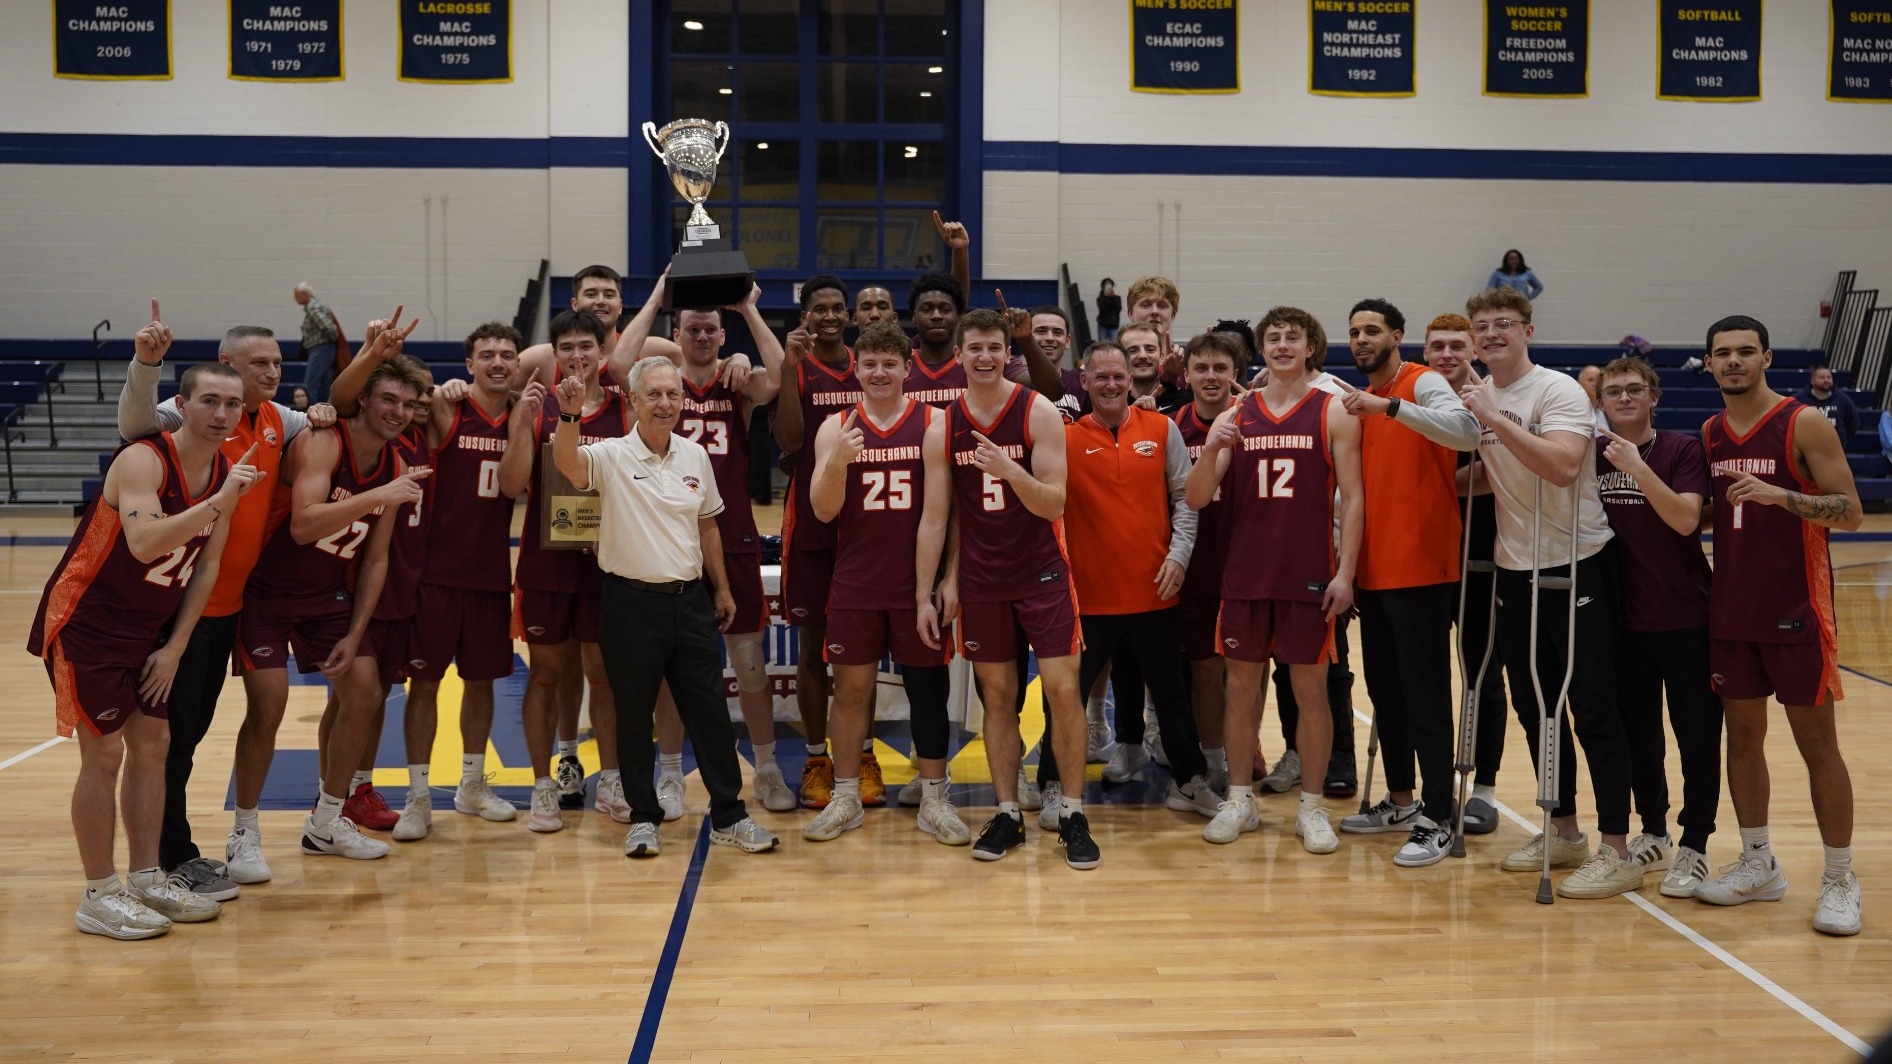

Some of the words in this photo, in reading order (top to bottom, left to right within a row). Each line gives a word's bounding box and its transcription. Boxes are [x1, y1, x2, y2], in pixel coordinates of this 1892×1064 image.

[95, 6, 129, 18] MAC
[269, 6, 302, 18] MAC
[418, 2, 492, 15] LACROSSE
[1314, 1, 1355, 13] MEN'S
[1357, 2, 1410, 14] SOCCER
[1505, 6, 1569, 18] WOMEN'S
[1677, 9, 1742, 22] SOFTBALL
[1849, 11, 1892, 24] SOFTB
[68, 19, 155, 32] CHAMPIONS
[242, 18, 329, 31] CHAMPIONS
[439, 21, 471, 33] MAC
[1165, 22, 1203, 34] ECAC
[1347, 20, 1378, 31] MAC
[1510, 20, 1563, 32] SOCCER
[412, 34, 497, 47] CHAMPIONS
[1144, 34, 1225, 48] CHAMPIONS
[1322, 31, 1402, 45] NORTHEAST
[1505, 37, 1567, 50] FREEDOM
[1694, 36, 1725, 48] MAC
[1843, 37, 1872, 50] MAC
[1875, 38, 1892, 50] NO
[96, 46, 132, 58] 2006
[245, 41, 272, 53] 1971
[297, 42, 326, 54] 1972
[1322, 45, 1402, 59] CHAMPIONS
[440, 53, 470, 65] 1975
[1498, 50, 1575, 63] CHAMPIONS
[1672, 48, 1748, 61] CHAMPIONS
[1842, 50, 1892, 63] CHAMPI
[271, 59, 301, 71] 1979
[1170, 60, 1200, 72] 1990
[1347, 69, 1377, 81] 1992
[1522, 68, 1554, 80] 2005
[1694, 75, 1724, 88] 1982
[1844, 76, 1870, 88] 1983
[683, 419, 729, 455] 23
[1244, 435, 1313, 451] SUSQUEHANNA
[852, 446, 920, 463] USQUEHANNA
[478, 460, 501, 498] 0
[1257, 458, 1295, 498] 12
[862, 470, 911, 510] 25
[982, 472, 1005, 511] 5
[316, 520, 369, 559] 22
[144, 545, 201, 587] 24
